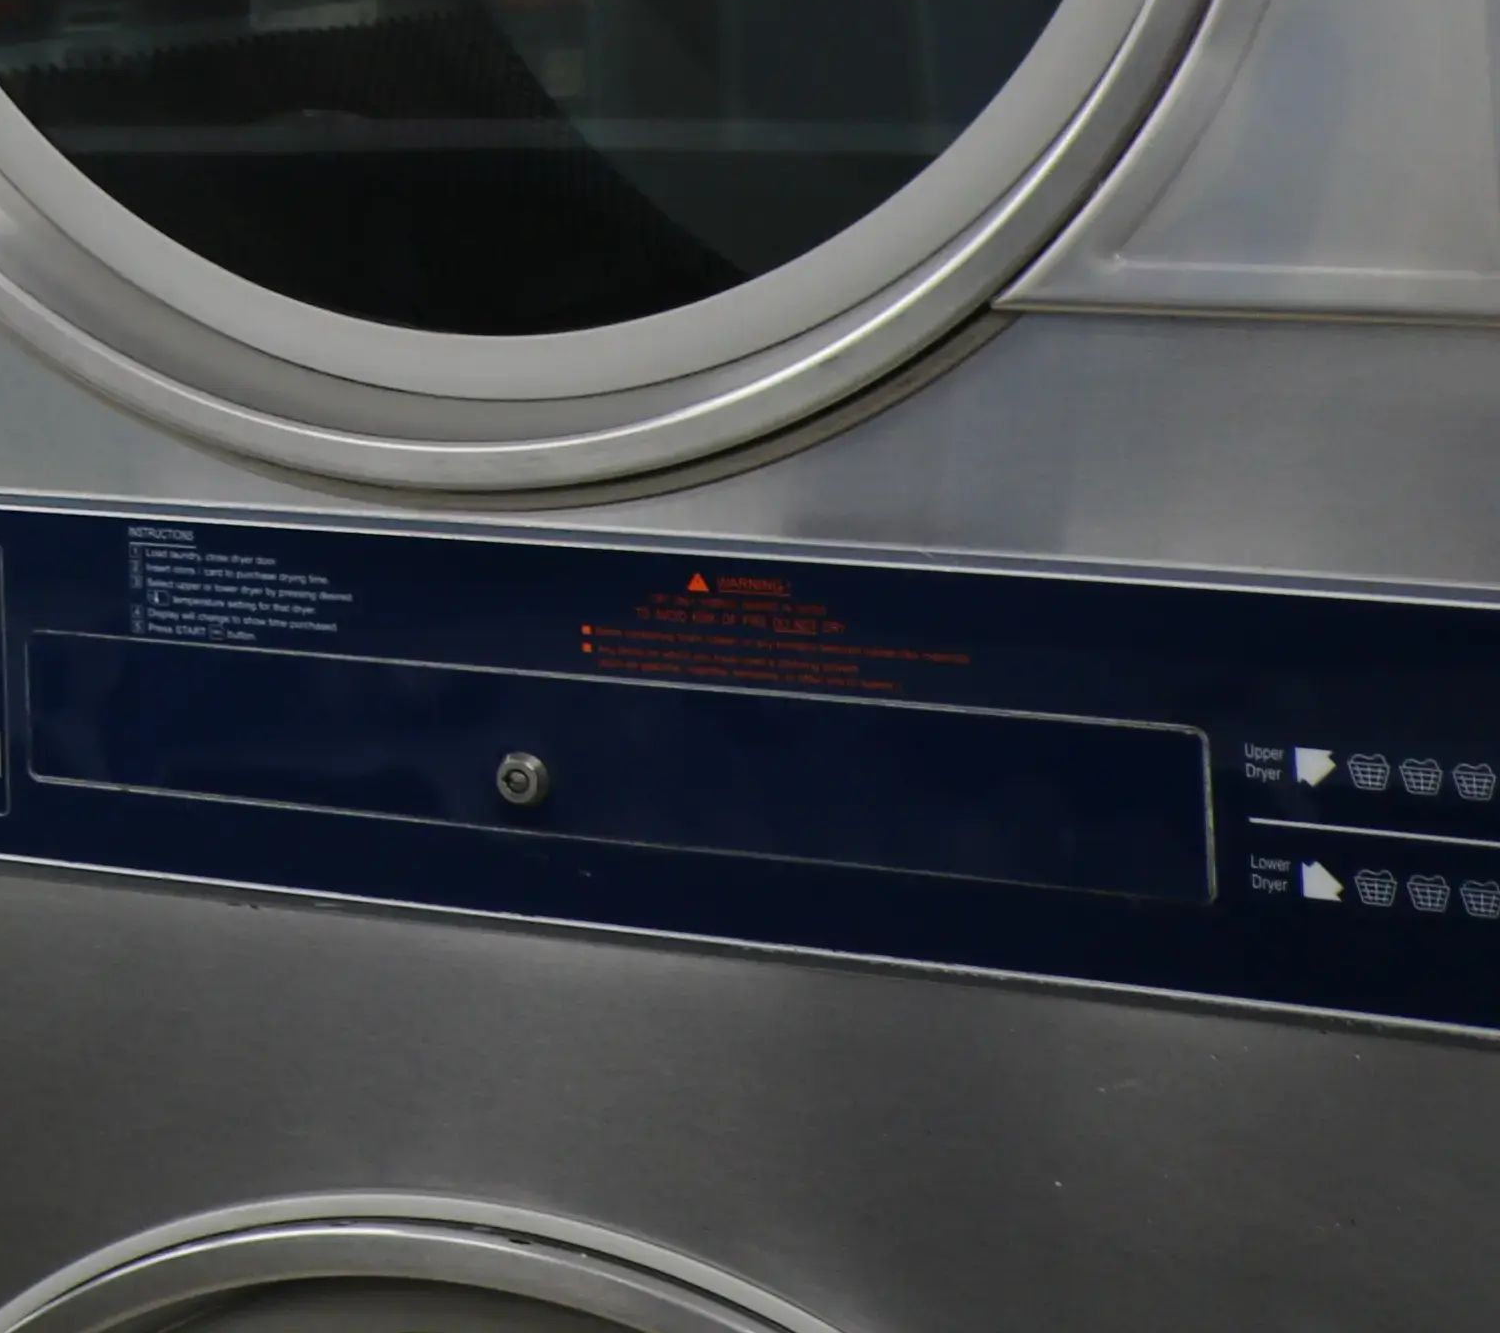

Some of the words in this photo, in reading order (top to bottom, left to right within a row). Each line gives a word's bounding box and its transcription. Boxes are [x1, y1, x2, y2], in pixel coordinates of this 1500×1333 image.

[1244, 742, 1285, 763] Upper
[1246, 762, 1282, 782] Dryer
[1250, 853, 1292, 873] Lower
[1252, 873, 1289, 893] Dryer
